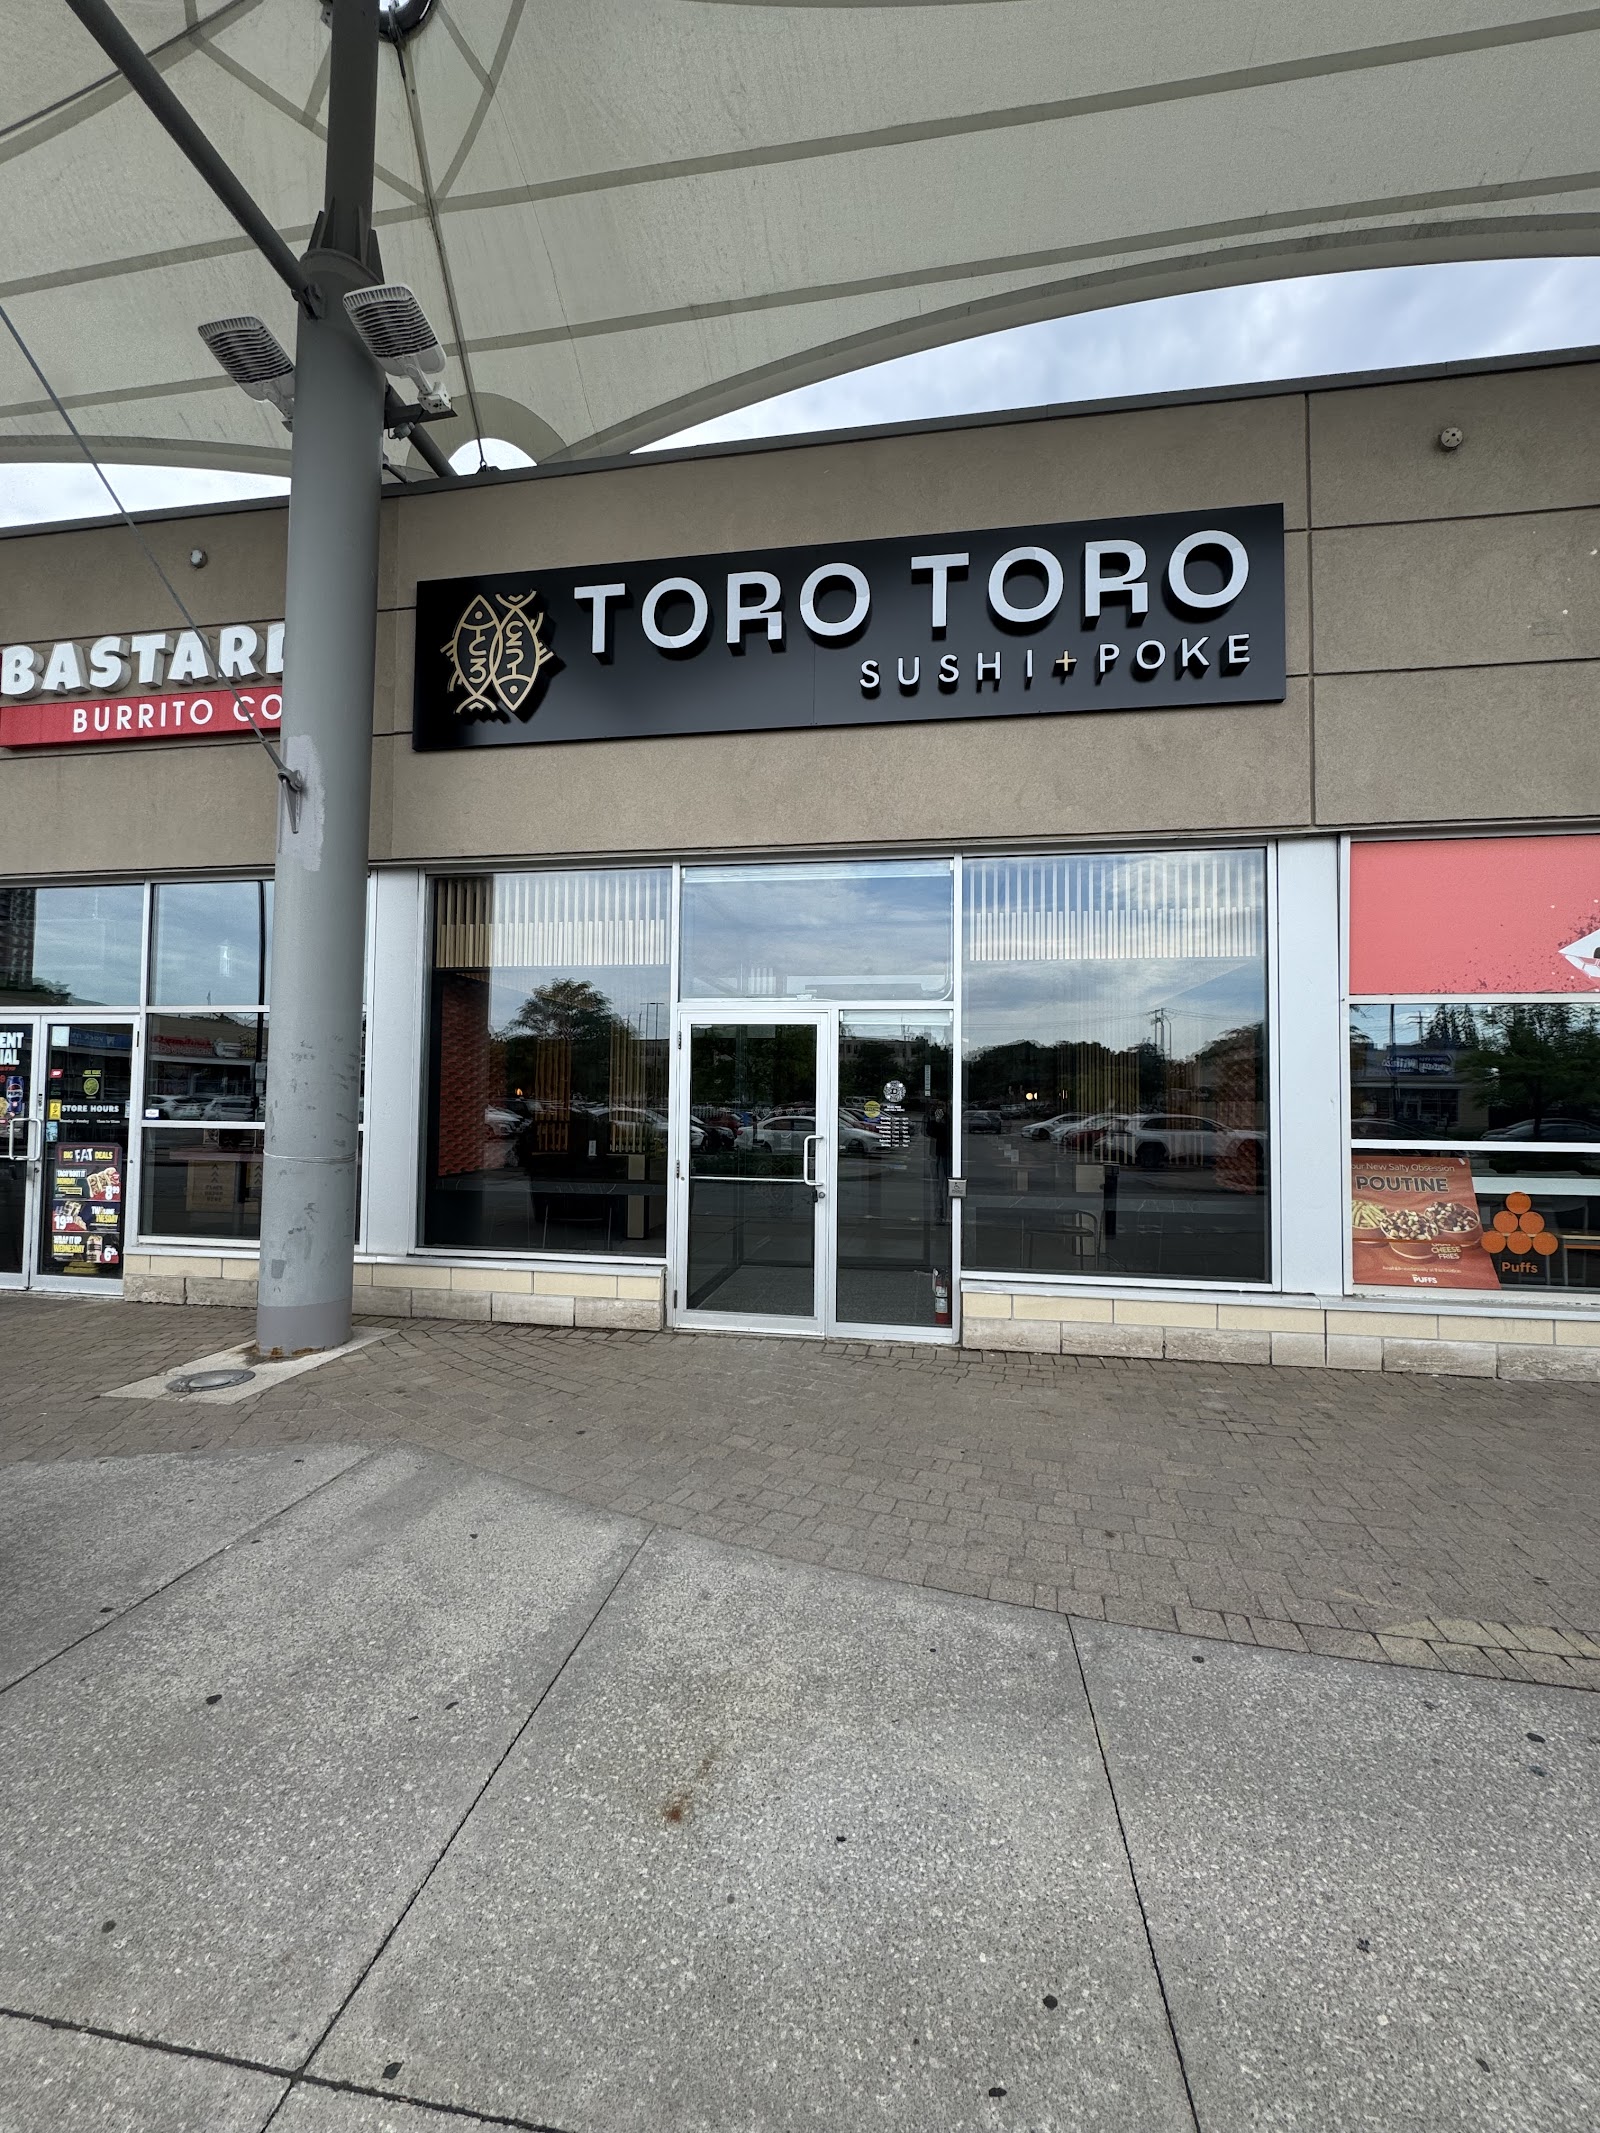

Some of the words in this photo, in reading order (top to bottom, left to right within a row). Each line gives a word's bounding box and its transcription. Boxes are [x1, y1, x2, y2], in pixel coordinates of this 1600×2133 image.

[574, 562, 871, 654] TORO
[911, 529, 1250, 628] TORO
[859, 650, 1034, 689] SUSHI
[1099, 633, 1250, 673] POKE
[73, 698, 213, 733] BURRITO
[233, 694, 282, 722] CO
[63, 1151, 73, 1159] BIG
[74, 1148, 93, 1162] FAT
[94, 1151, 113, 1160] DEALS
[1366, 1163, 1387, 1171] New
[1388, 1164, 1410, 1173] Salty
[1411, 1164, 1455, 1172] Obsession
[1355, 1174, 1449, 1193] POUTINE
[96, 1214, 118, 1223] TUESDAY
[53, 1245, 85, 1253] WEDNESDAY
[1501, 1262, 1538, 1274] Puffs
